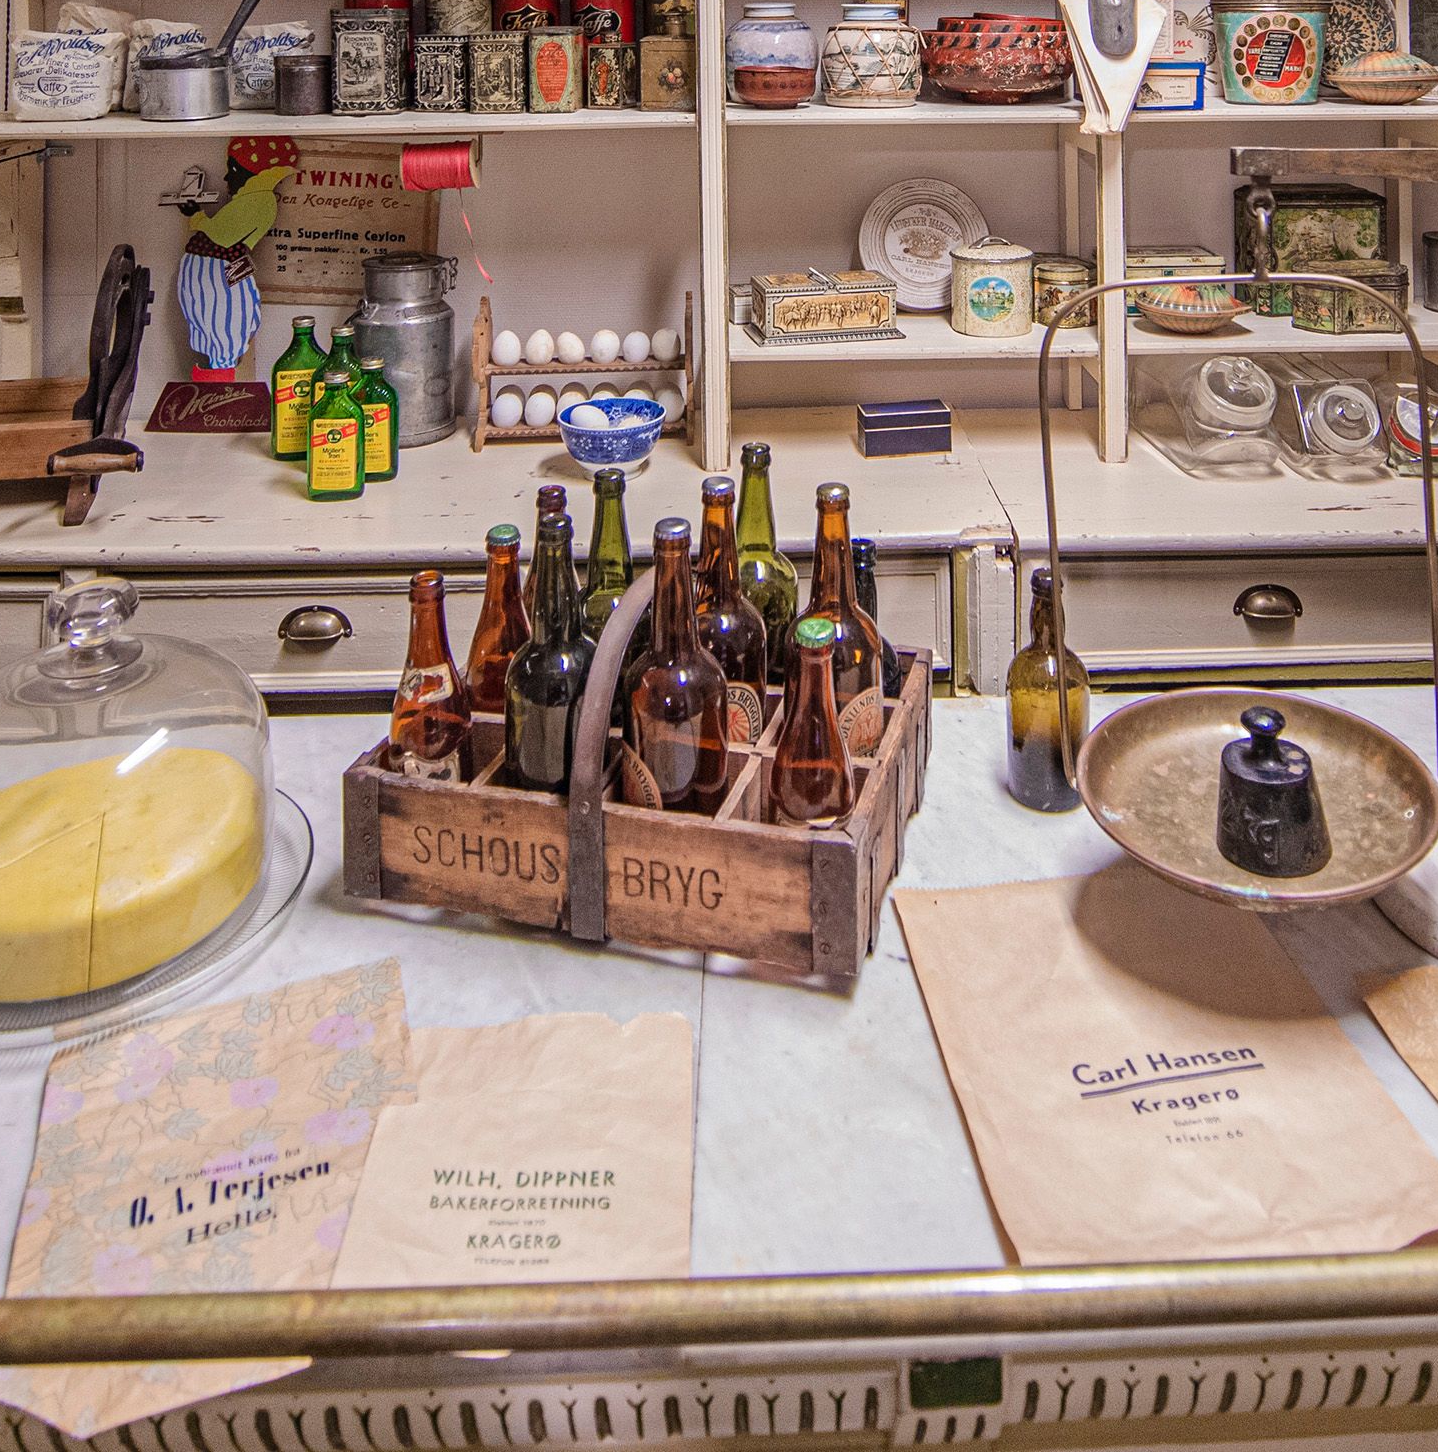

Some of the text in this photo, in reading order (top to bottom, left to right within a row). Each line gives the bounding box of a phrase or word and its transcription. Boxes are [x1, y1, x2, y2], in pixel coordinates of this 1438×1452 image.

[303, 193, 374, 210] Kongelige
[266, 227, 406, 243] xtra Superfine Ceylon
[202, 413, 269, 428] Chokolade
[412, 825, 724, 911] SCHOUS BRYG
[1071, 1046, 1258, 1086] Carl Hansen
[1130, 1087, 1240, 1115] Kragerø
[1226, 1128, 1245, 1140] 66
[205, 1160, 331, 1206] Terjesen
[515, 1169, 617, 1188] DIPPNER
[428, 1194, 611, 1212] BAKERFORRETNING
[465, 1233, 562, 1250] KRAGERØ
